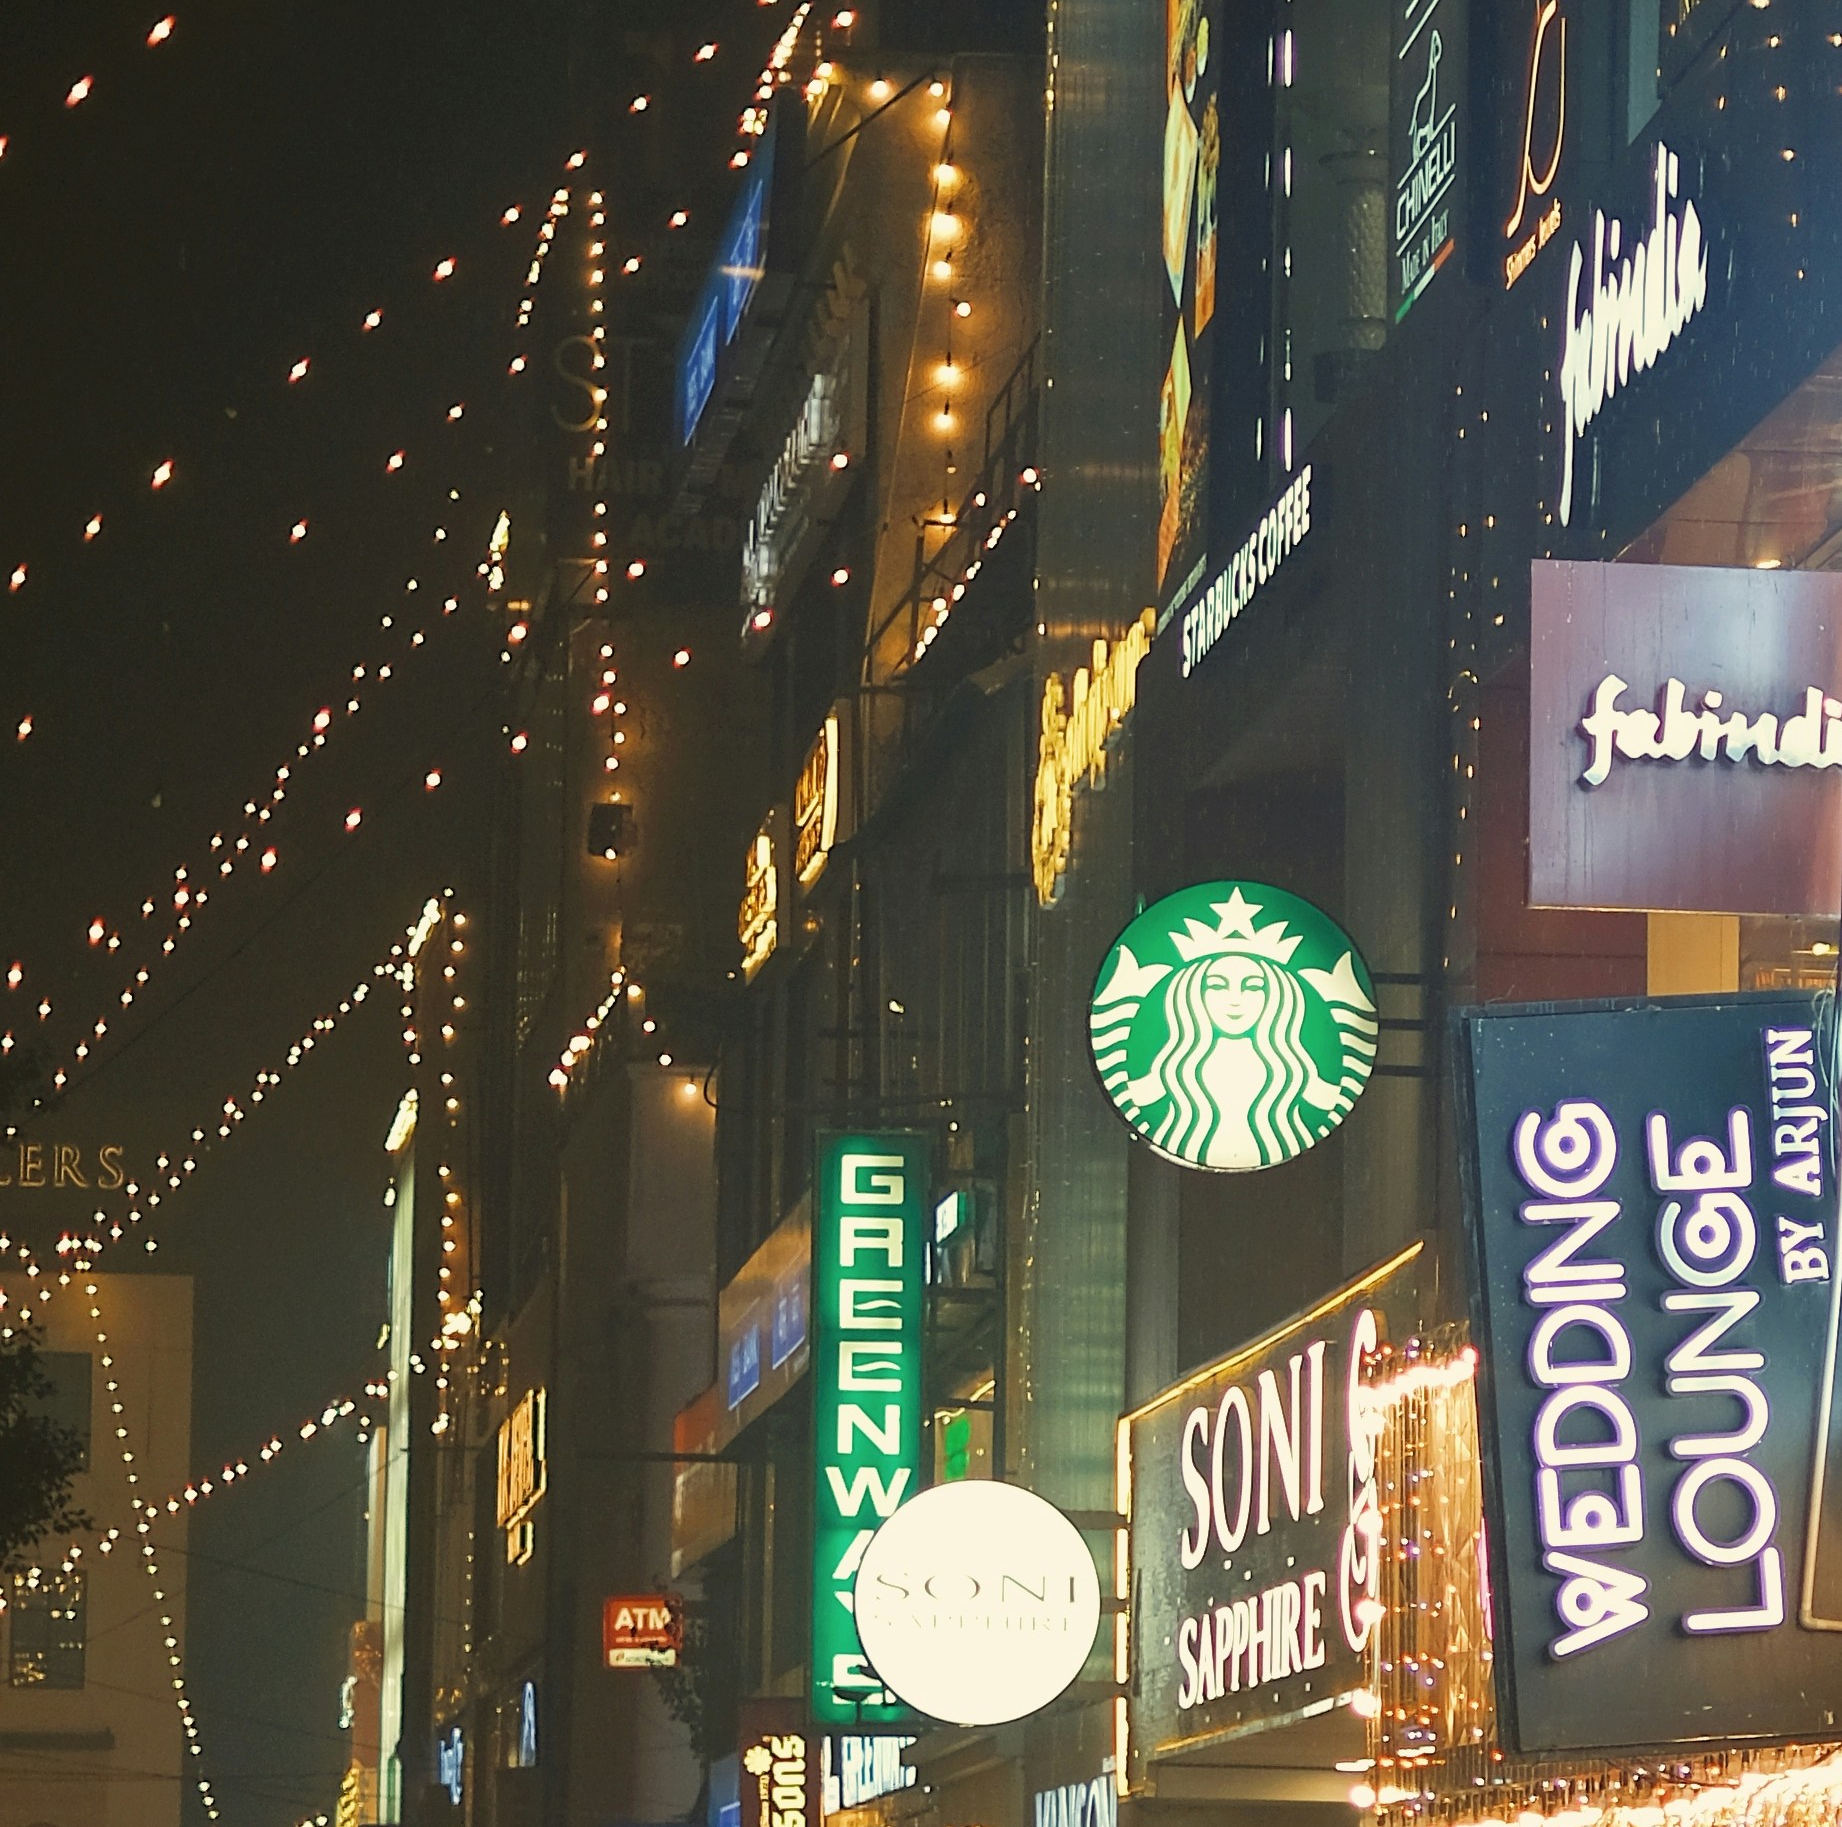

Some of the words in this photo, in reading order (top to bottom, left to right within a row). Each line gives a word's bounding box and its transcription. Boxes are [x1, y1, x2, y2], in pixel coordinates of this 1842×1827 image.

[1396, 120, 1456, 241] CHINELLI
[1182, 532, 1257, 679] STARBUCKS
[1258, 464, 1312, 585] COFFEE
[1765, 1027, 1826, 1197] ARJUN
[1781, 1215, 1830, 1284] BY
[1515, 1098, 1650, 1662] WEDDING
[1646, 1107, 1785, 1634] LOUNGE
[1181, 1338, 1328, 1572] SONI
[614, 1607, 672, 1631] ATM
[876, 1572, 1076, 1603] SONI
[1177, 1570, 1327, 1712] SAPPHIRE
